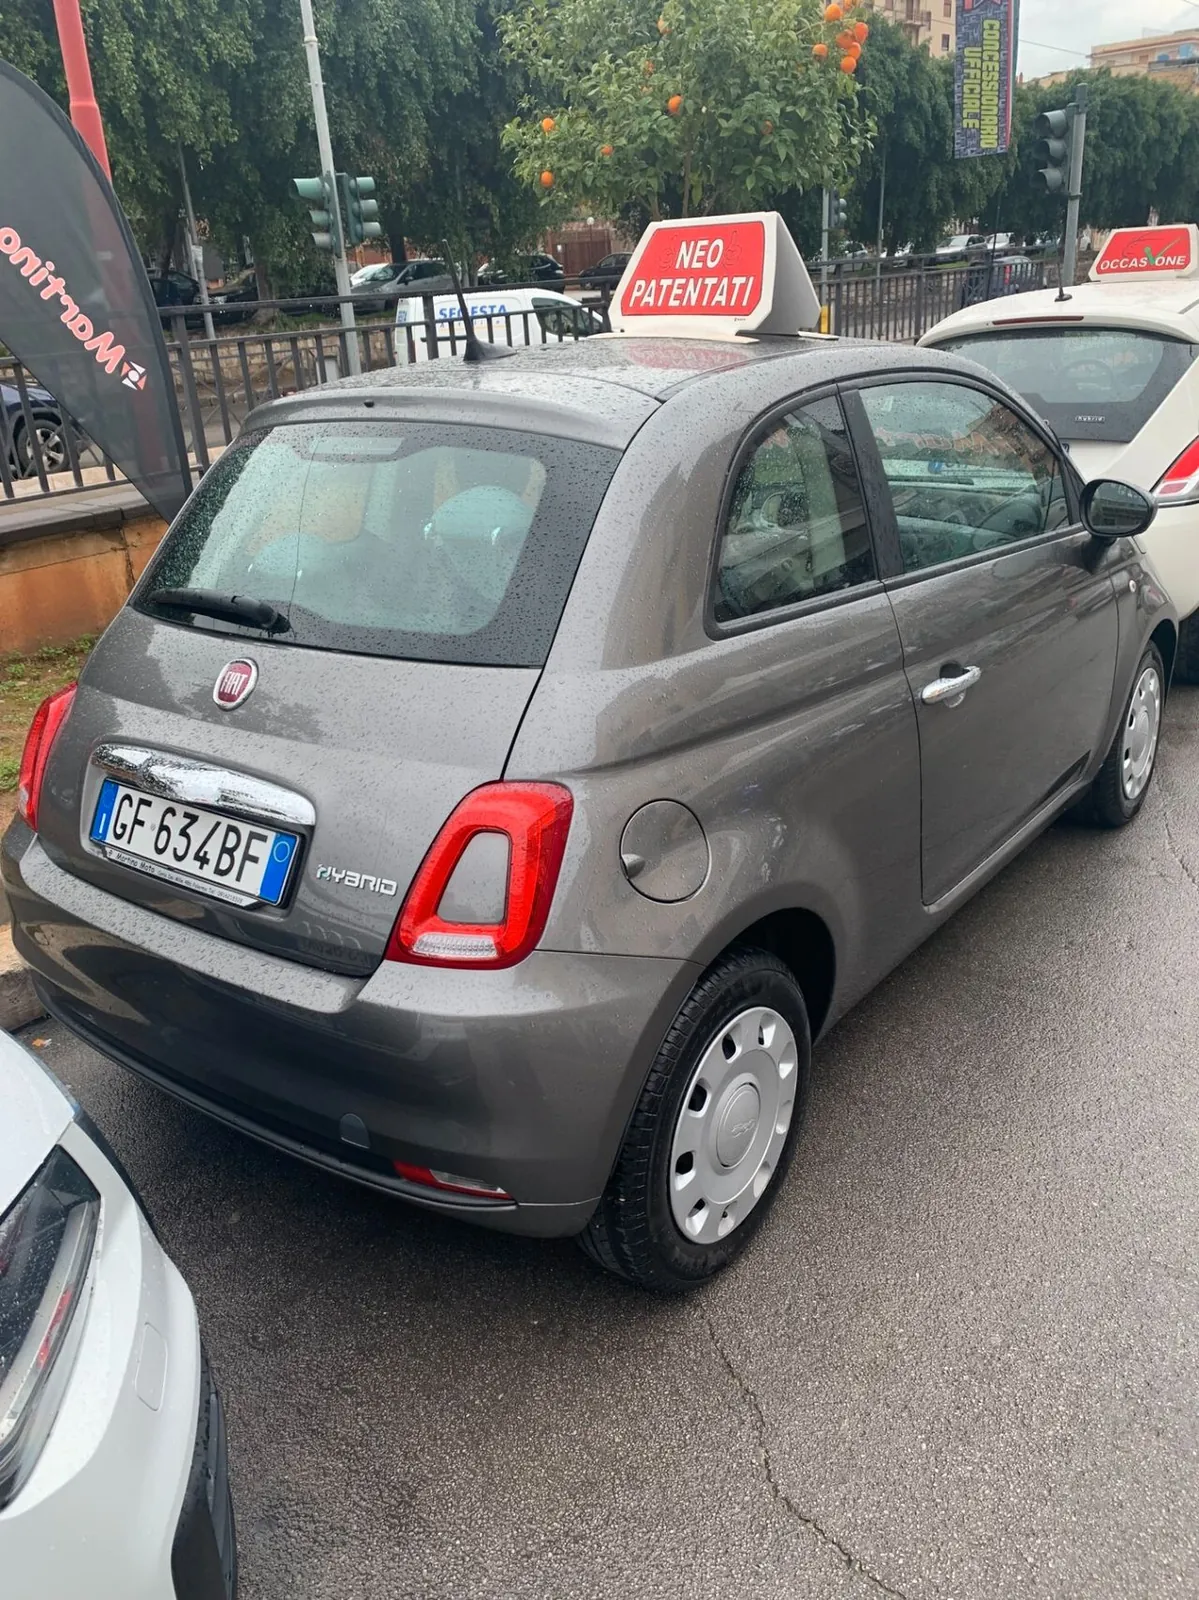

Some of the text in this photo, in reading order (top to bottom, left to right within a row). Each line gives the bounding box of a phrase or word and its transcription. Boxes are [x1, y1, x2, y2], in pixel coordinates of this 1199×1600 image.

[963, 47, 982, 129] UFFICIALE
[980, 19, 1000, 148] CONCESSIONARIO
[675, 238, 724, 269] NEO
[628, 276, 754, 307] PATENTATI
[220, 671, 249, 695] FIAT
[113, 793, 268, 882] GF 634BF
